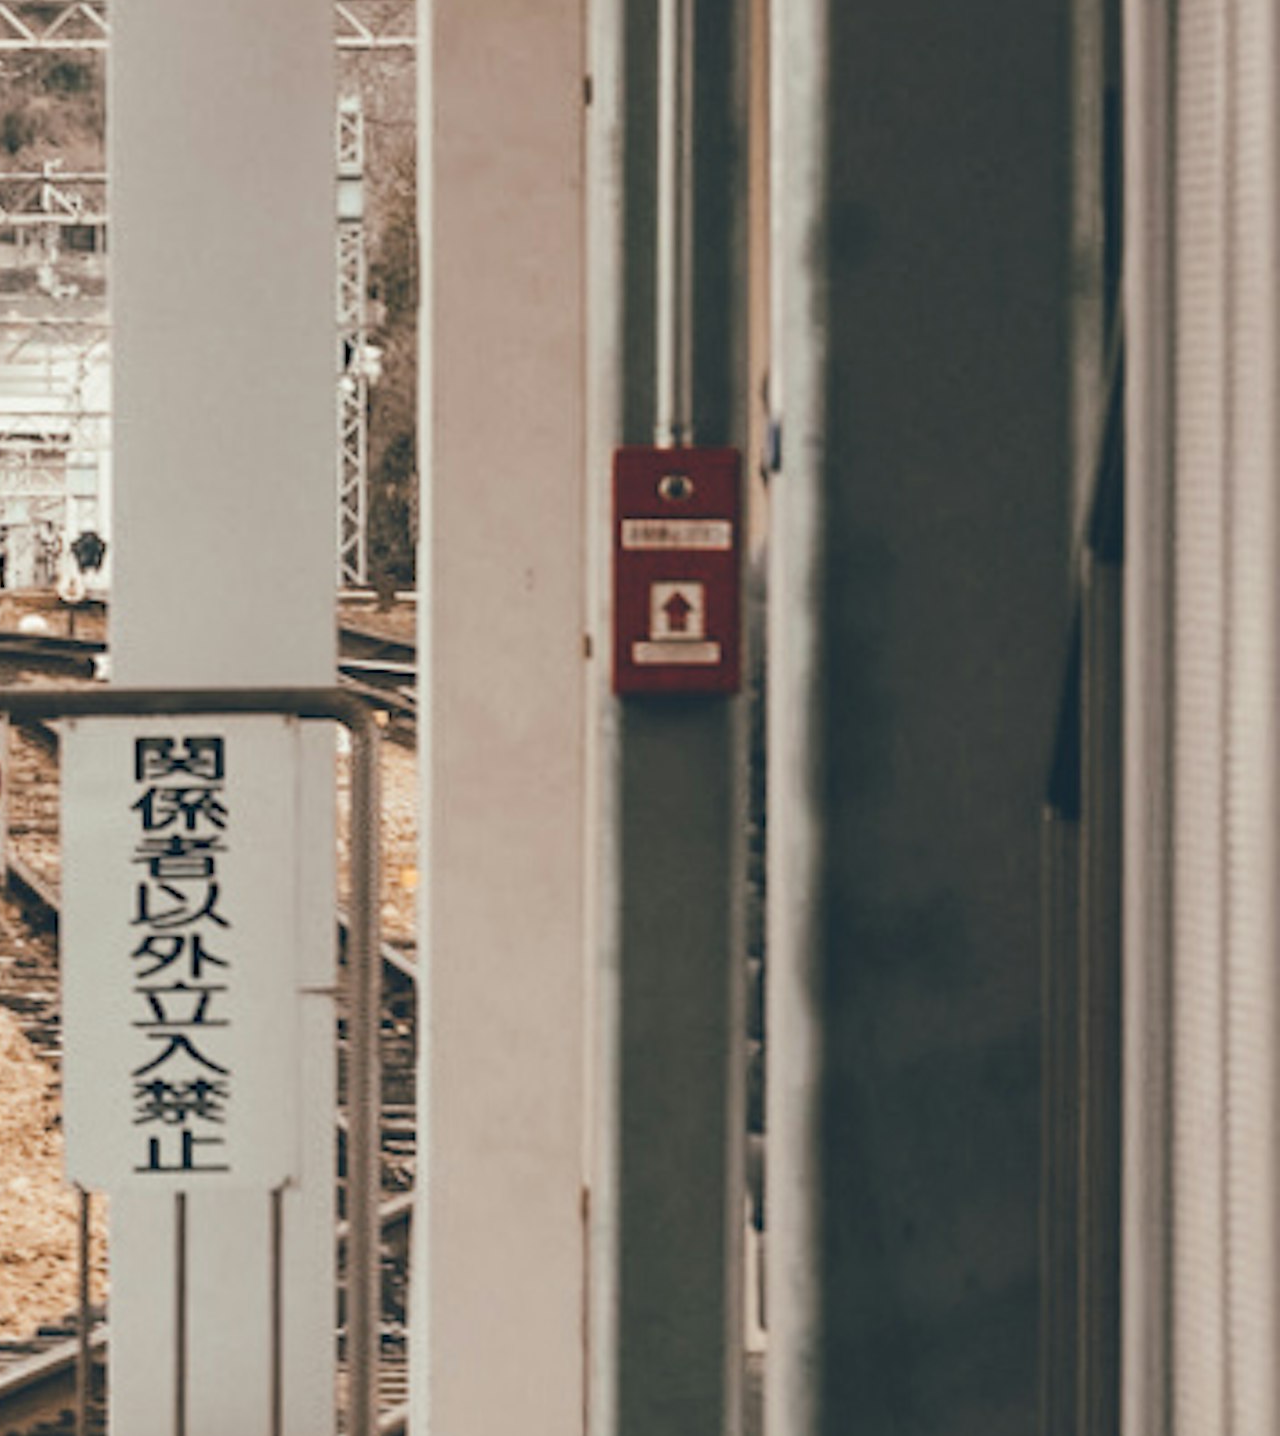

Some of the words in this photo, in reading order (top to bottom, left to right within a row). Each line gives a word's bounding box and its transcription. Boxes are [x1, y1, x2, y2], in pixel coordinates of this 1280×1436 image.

[129, 735, 232, 1174] 関係者以外立入禁止
